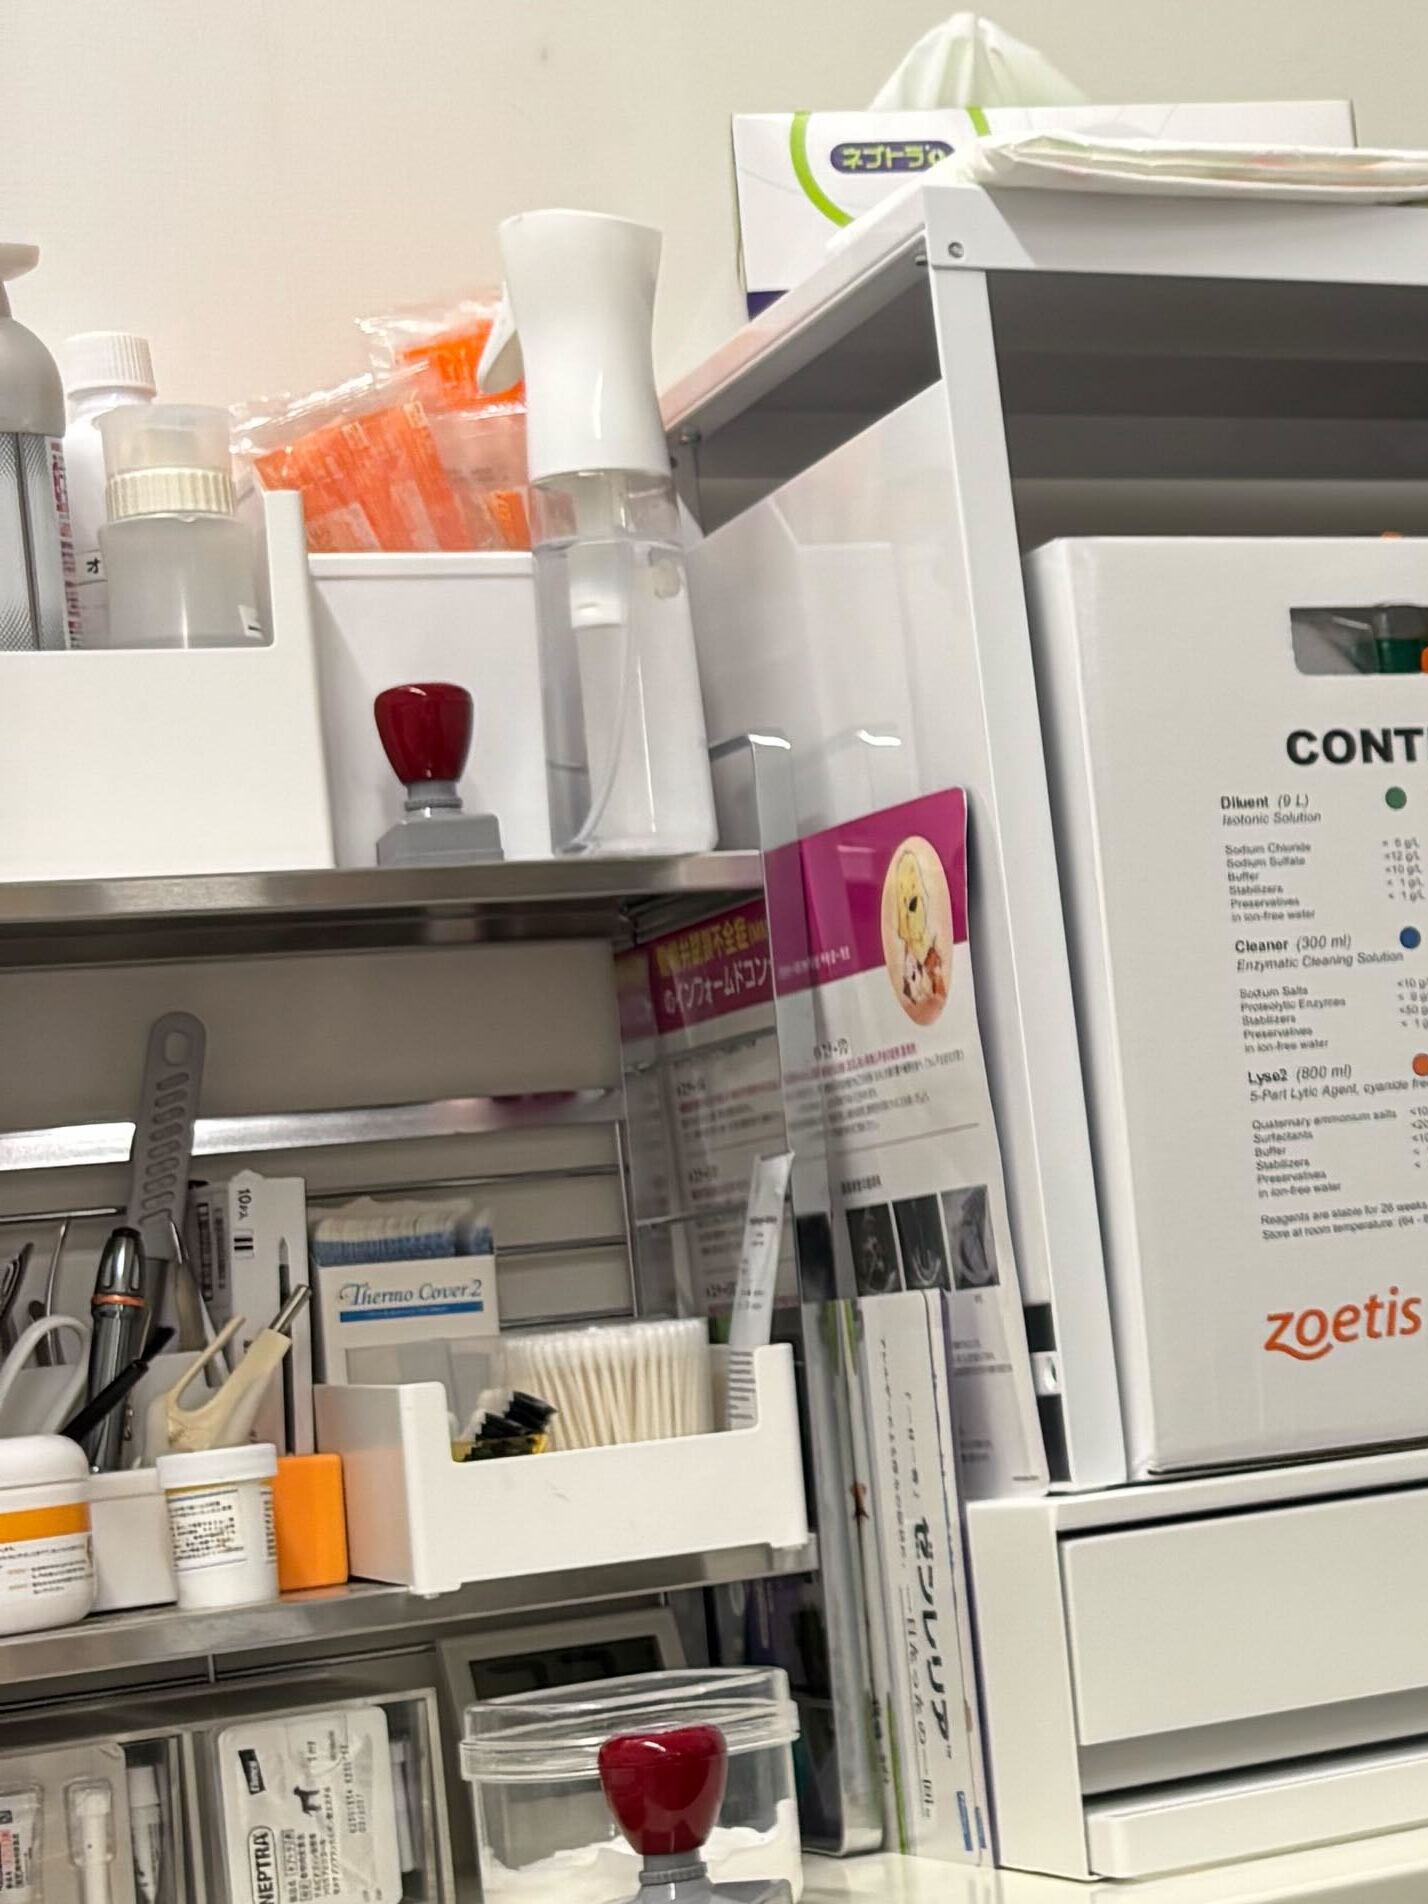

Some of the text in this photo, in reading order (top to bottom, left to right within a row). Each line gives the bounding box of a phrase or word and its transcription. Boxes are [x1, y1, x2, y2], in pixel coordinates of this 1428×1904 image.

[1220, 795, 1269, 810] Diluent
[1222, 811, 1322, 827] Isotonic Solution
[1225, 843, 1265, 856] Sodium
[1226, 857, 1267, 869] Sodium
[1228, 870, 1260, 883] Buffer
[1235, 934, 1352, 954] Cleaner (300 ml)
[1236, 950, 1405, 973] Enzymatic Cleaning Solution
[1248, 1063, 1352, 1087] Lyse2 (800 ml)
[339, 1279, 483, 1307] Thermo Cover 2
[1264, 1284, 1423, 1361] zoetis
[913, 1513, 949, 1742] ゼンレリア
